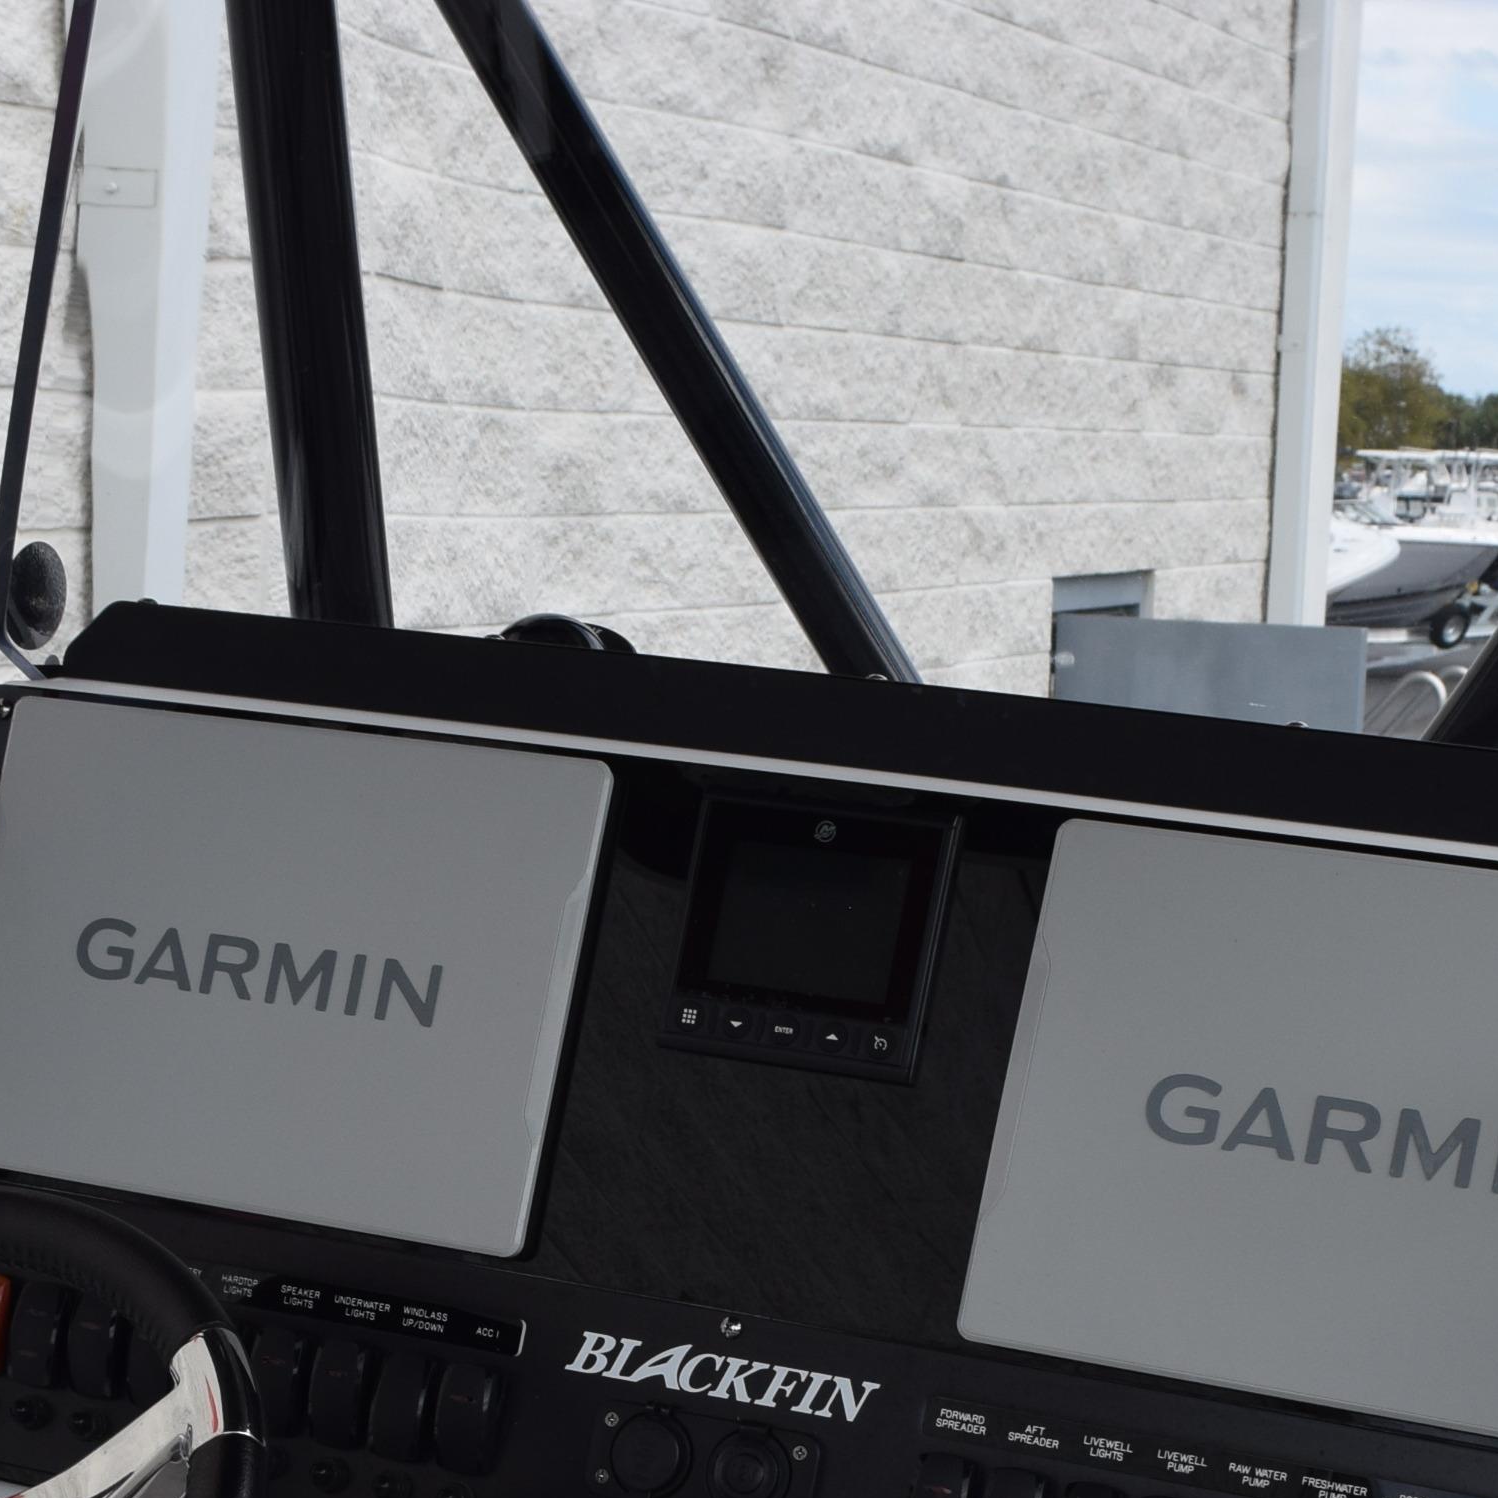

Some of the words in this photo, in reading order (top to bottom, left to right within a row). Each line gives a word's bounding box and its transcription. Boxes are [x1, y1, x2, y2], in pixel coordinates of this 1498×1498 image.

[76, 916, 443, 1028] GARMIN
[774, 1025, 793, 1035] ENTER
[222, 1273, 258, 1288] HARDTOP
[223, 1285, 253, 1298] LIGHTS
[281, 1284, 321, 1299] SPEAKER
[283, 1296, 313, 1309] LIGHTS
[334, 1295, 391, 1312] UNDERWATER
[345, 1307, 376, 1321] LIGHTS
[403, 1306, 448, 1322] WINDLASS
[402, 1318, 444, 1333] UP/DOWN
[475, 1327, 494, 1338] ACC
[564, 1331, 881, 1422] BLACKFIN
[940, 1408, 986, 1425] FORWARD
[935, 1418, 987, 1436] SPREADER
[1025, 1425, 1045, 1437] AFT
[1007, 1431, 1059, 1450] SPREADER
[1083, 1435, 1133, 1453] LIVEWELL
[1090, 1448, 1124, 1462] LIGHTS
[1157, 1449, 1207, 1467] LIVEWELL
[1167, 1461, 1195, 1475] PUMP
[1228, 1462, 1250, 1475] RAW
[1255, 1468, 1288, 1482] WATER
[1241, 1475, 1270, 1489] PUMP
[1302, 1476, 1368, 1497] FRESHWATER
